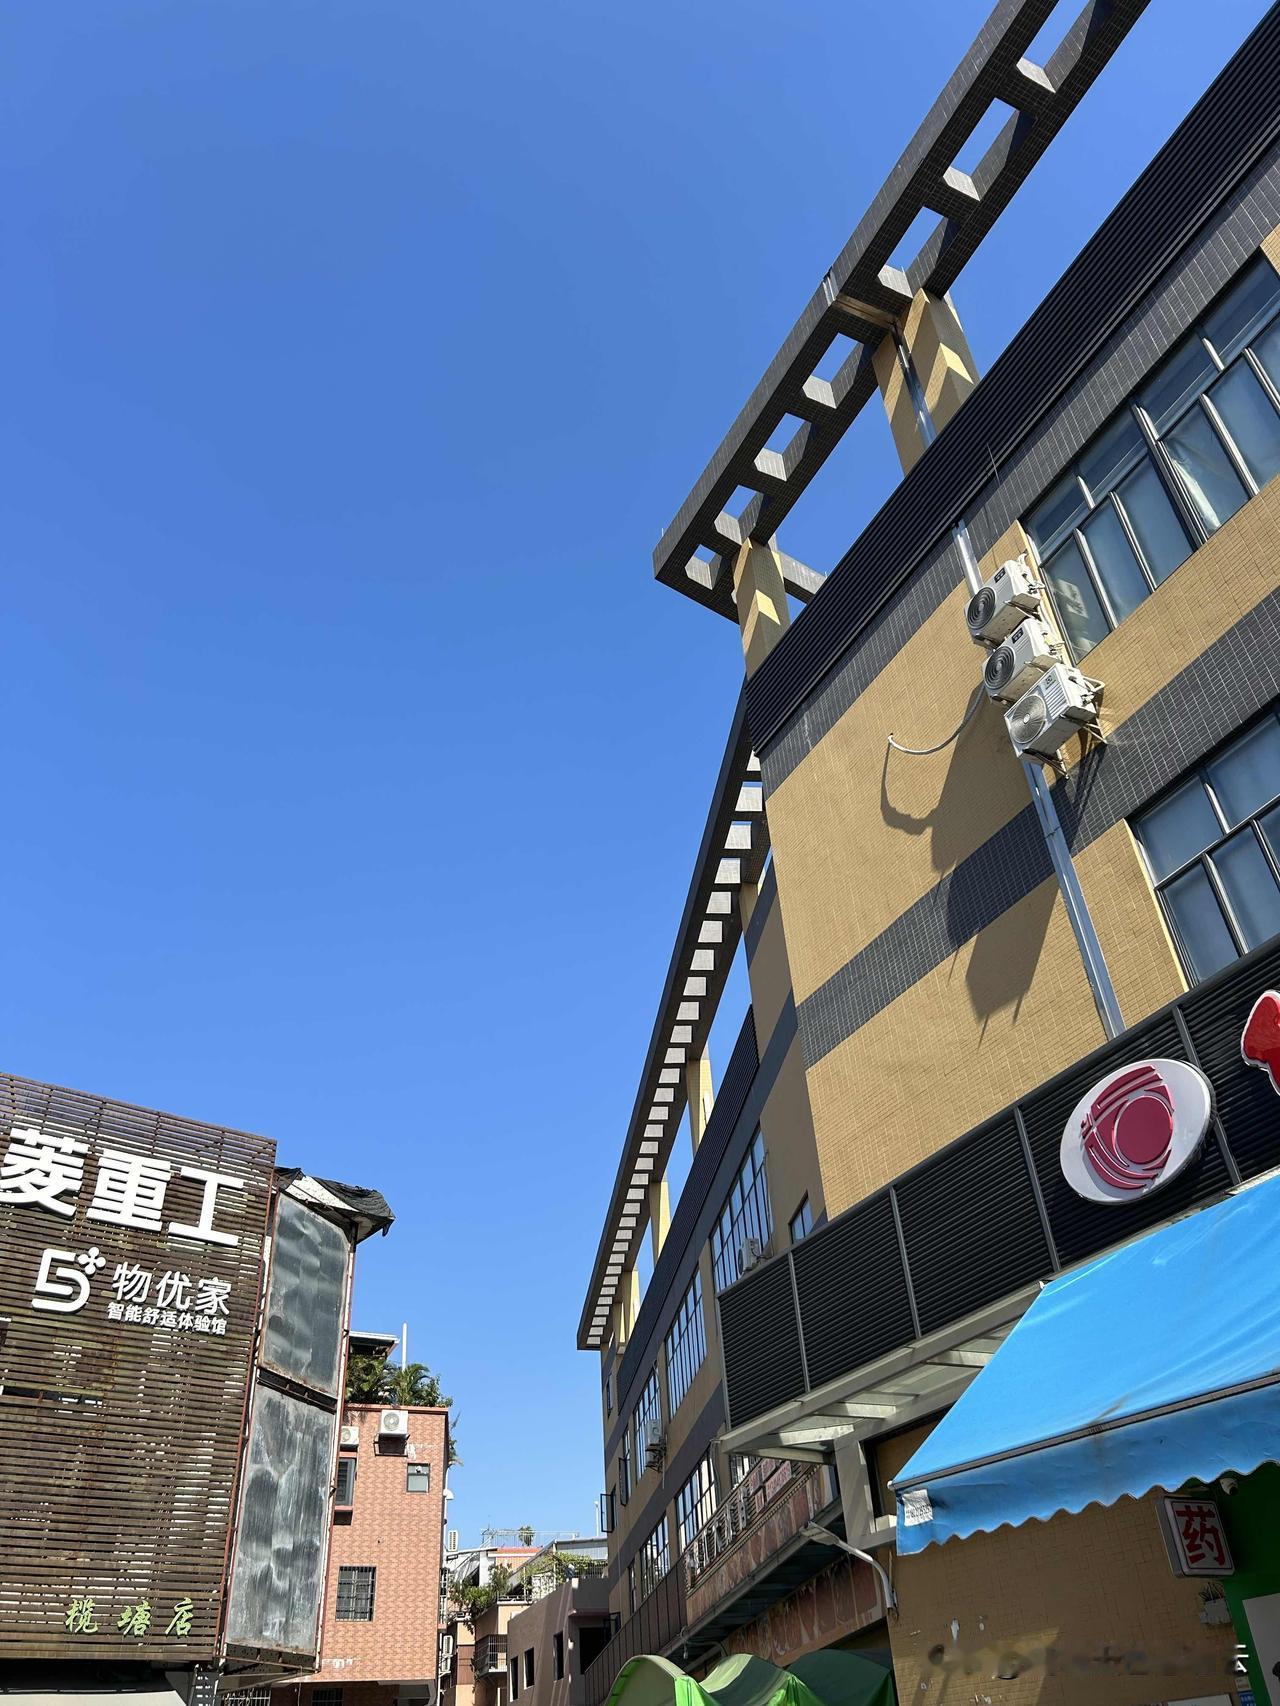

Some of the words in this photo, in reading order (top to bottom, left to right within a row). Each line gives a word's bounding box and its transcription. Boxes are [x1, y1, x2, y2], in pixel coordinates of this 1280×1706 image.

[0, 1127, 244, 1246] 菱重工
[112, 1261, 232, 1316] 物优家
[107, 1301, 227, 1336] 智能舒适体验馆
[1175, 1504, 1226, 1566] 药
